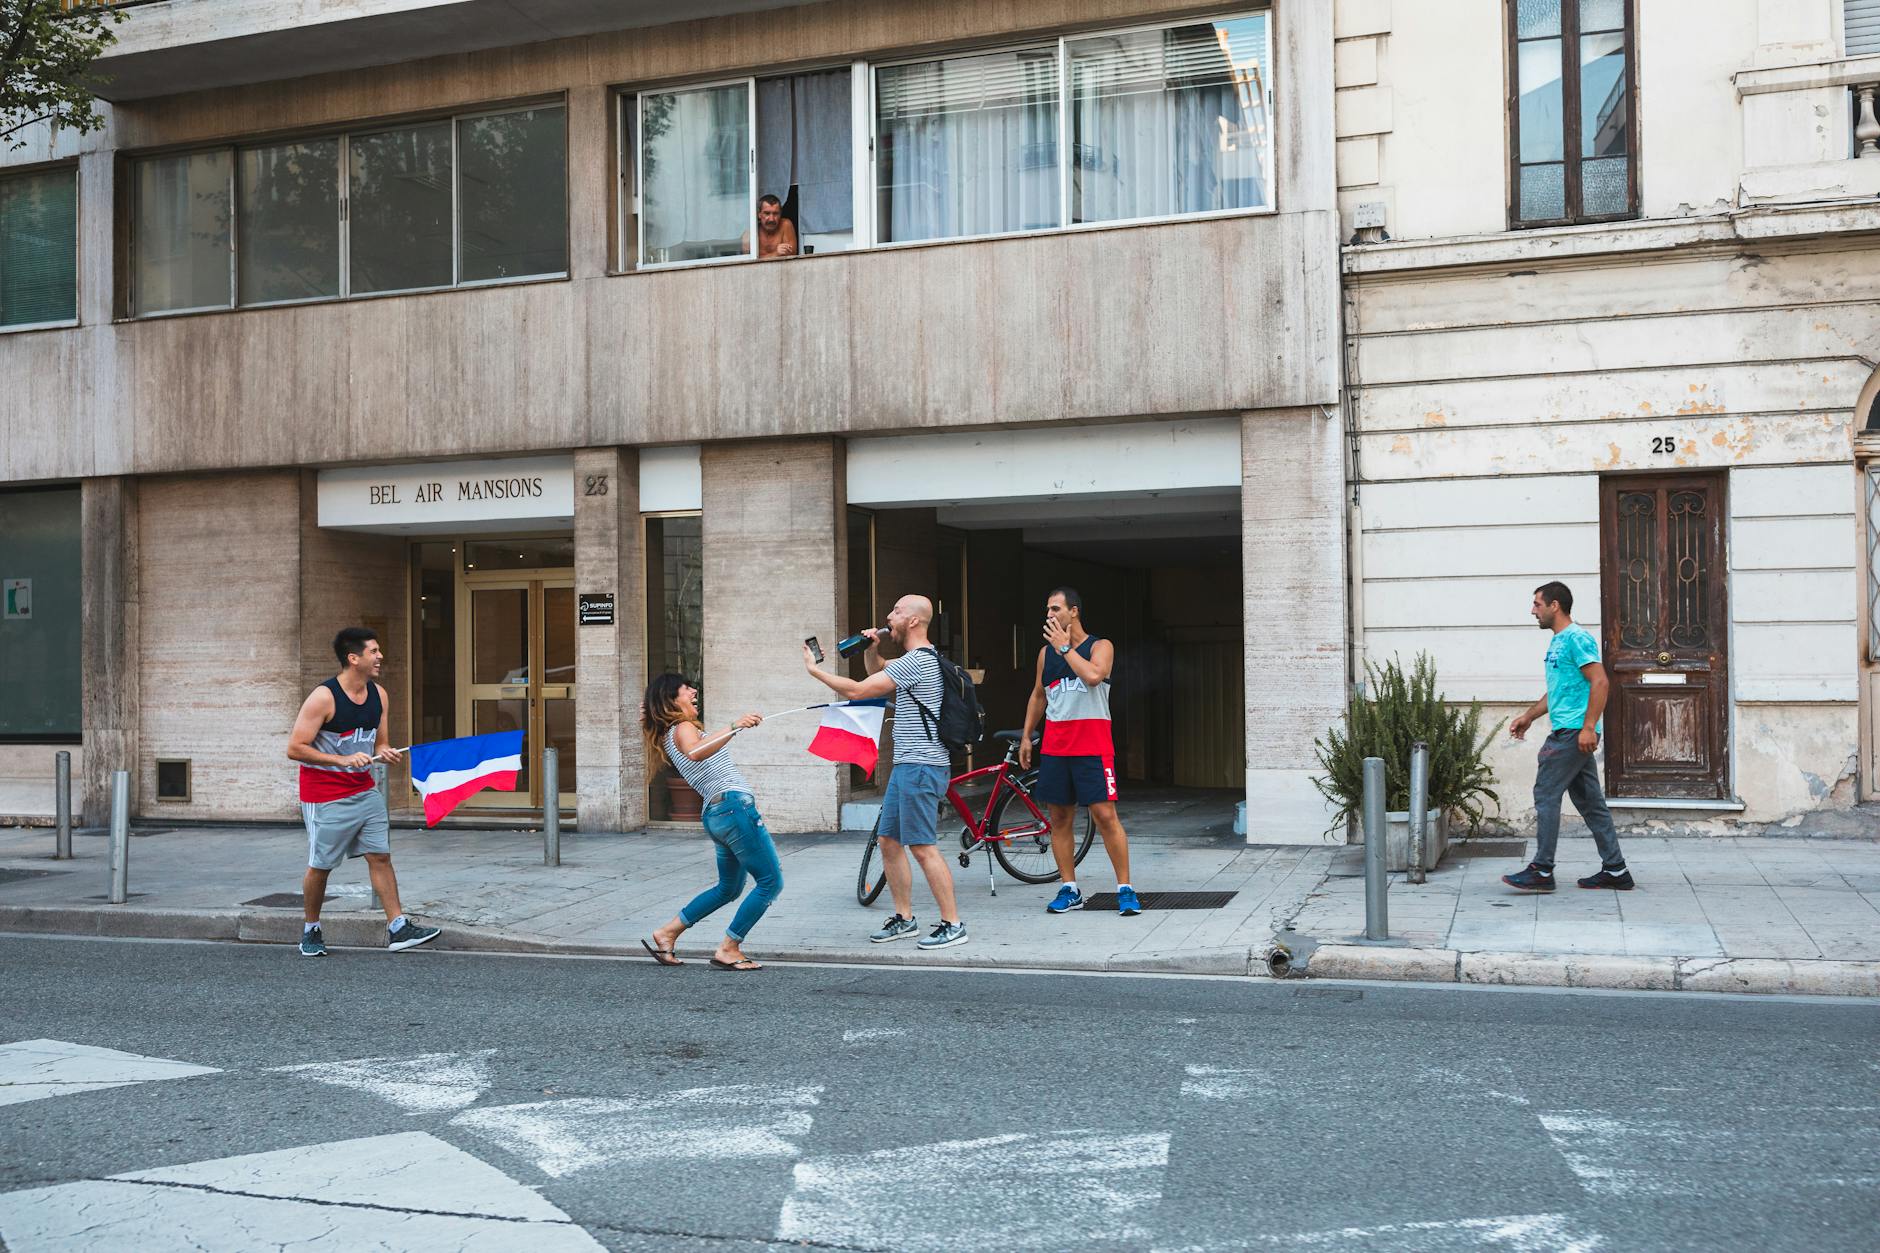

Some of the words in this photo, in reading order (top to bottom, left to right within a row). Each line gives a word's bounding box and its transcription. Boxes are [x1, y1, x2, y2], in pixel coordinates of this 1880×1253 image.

[1652, 436, 1676, 454] 25
[369, 485, 401, 505] BEL
[415, 482, 443, 503] AIR
[458, 477, 543, 501] MANSIONS
[585, 474, 609, 496] 23
[1048, 676, 1088, 700] FILA
[336, 727, 377, 747] FILA
